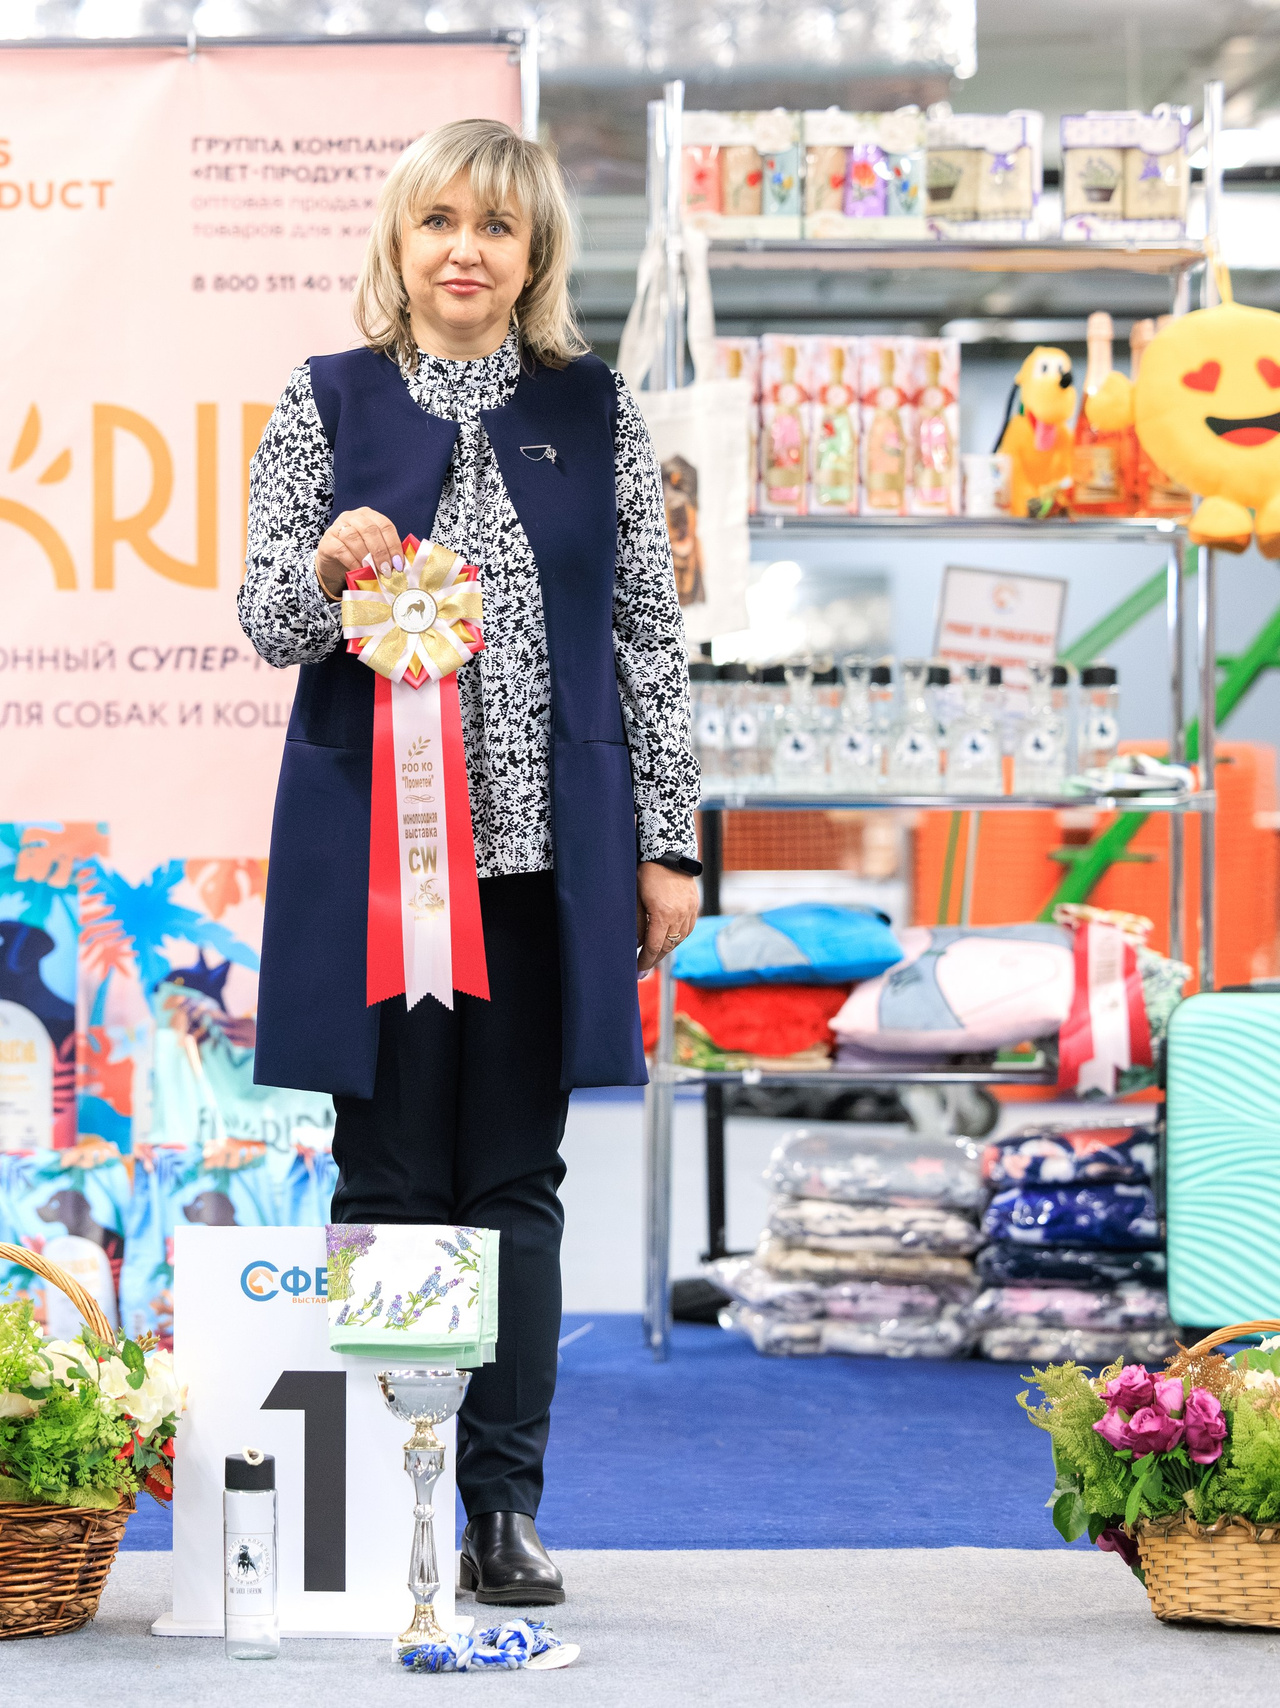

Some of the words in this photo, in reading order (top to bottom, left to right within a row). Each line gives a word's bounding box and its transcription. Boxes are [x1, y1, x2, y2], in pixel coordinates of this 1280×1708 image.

[192, 137, 284, 153] ГРУППА
[293, 137, 413, 153] КОМПАНИ
[193, 275, 205, 292] 8
[213, 275, 259, 292] 800
[266, 275, 296, 292] 511
[303, 275, 331, 292] 40
[53, 701, 168, 729] СОБАК
[179, 702, 202, 728] И
[402, 763, 419, 773] РОО
[421, 762, 433, 772] КО
[409, 846, 438, 875] CW
[259, 1371, 347, 1592] 1
